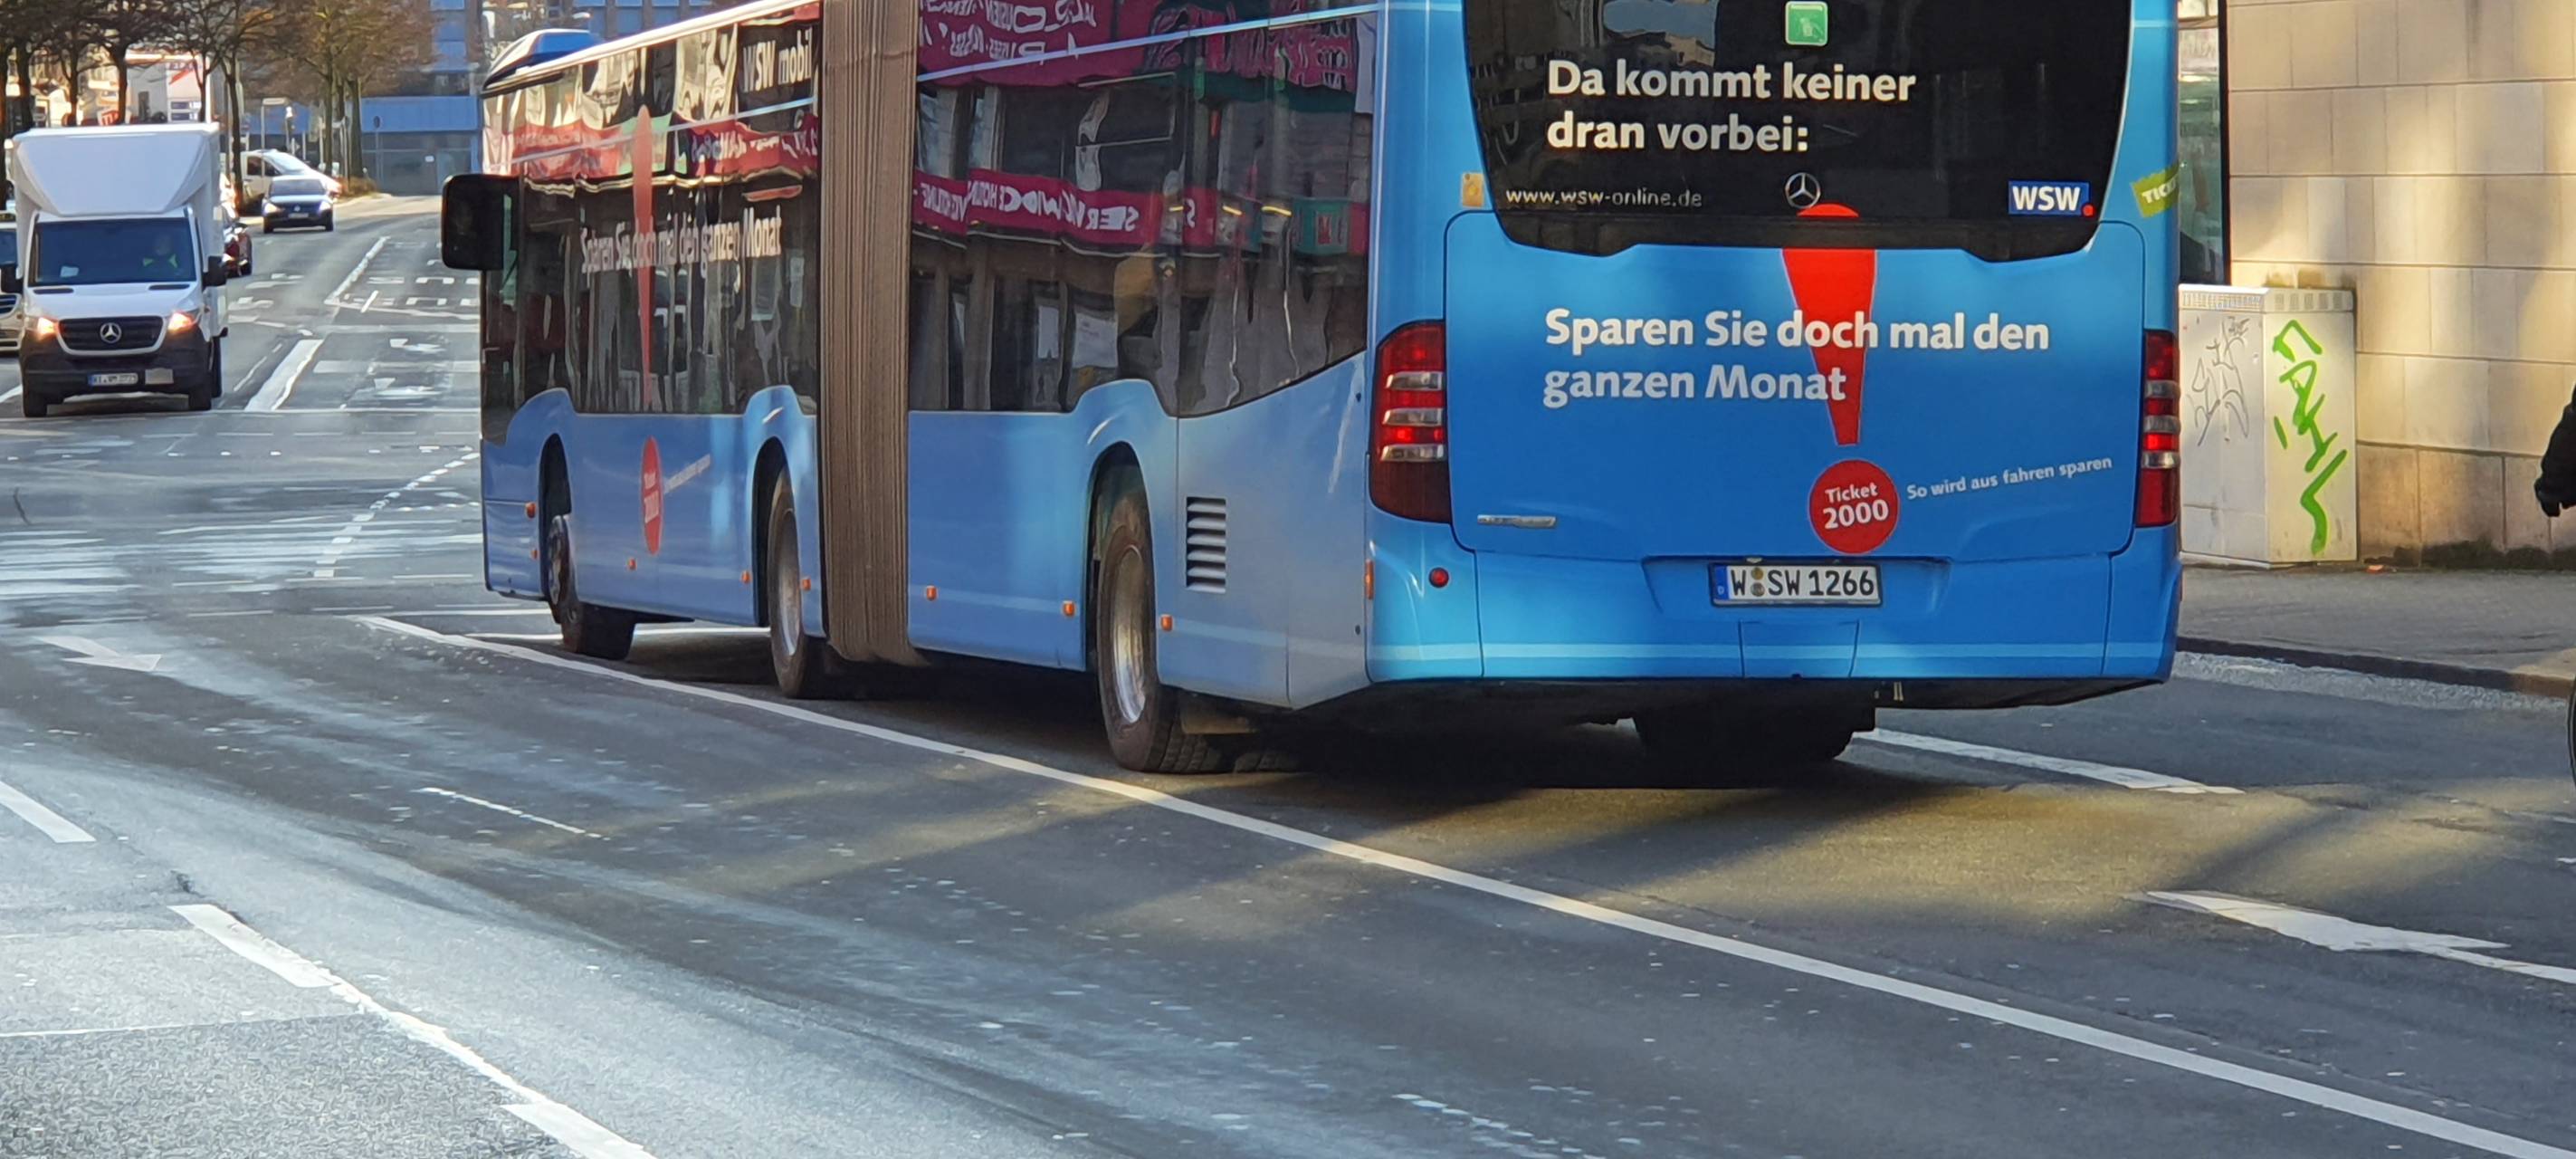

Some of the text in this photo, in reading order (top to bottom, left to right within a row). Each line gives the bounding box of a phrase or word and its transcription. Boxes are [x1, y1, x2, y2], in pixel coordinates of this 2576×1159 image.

[778, 26, 813, 85] mobil
[1547, 59, 1917, 101] Da kommt keiner
[1547, 110, 1809, 152] dran vorbei:
[1505, 187, 1703, 207] www.wsw-online.de
[1545, 308, 2050, 356] Sparen Sie doch mal den
[1543, 364, 1847, 408] ganzen Monat
[1825, 482, 1878, 503] Ticket
[1906, 456, 2113, 500] So wird aus fahren sparen
[1822, 499, 1890, 530] 2000
[1730, 569, 1747, 597] W
[1767, 569, 1801, 597] SW
[1808, 569, 1875, 598] 1266
